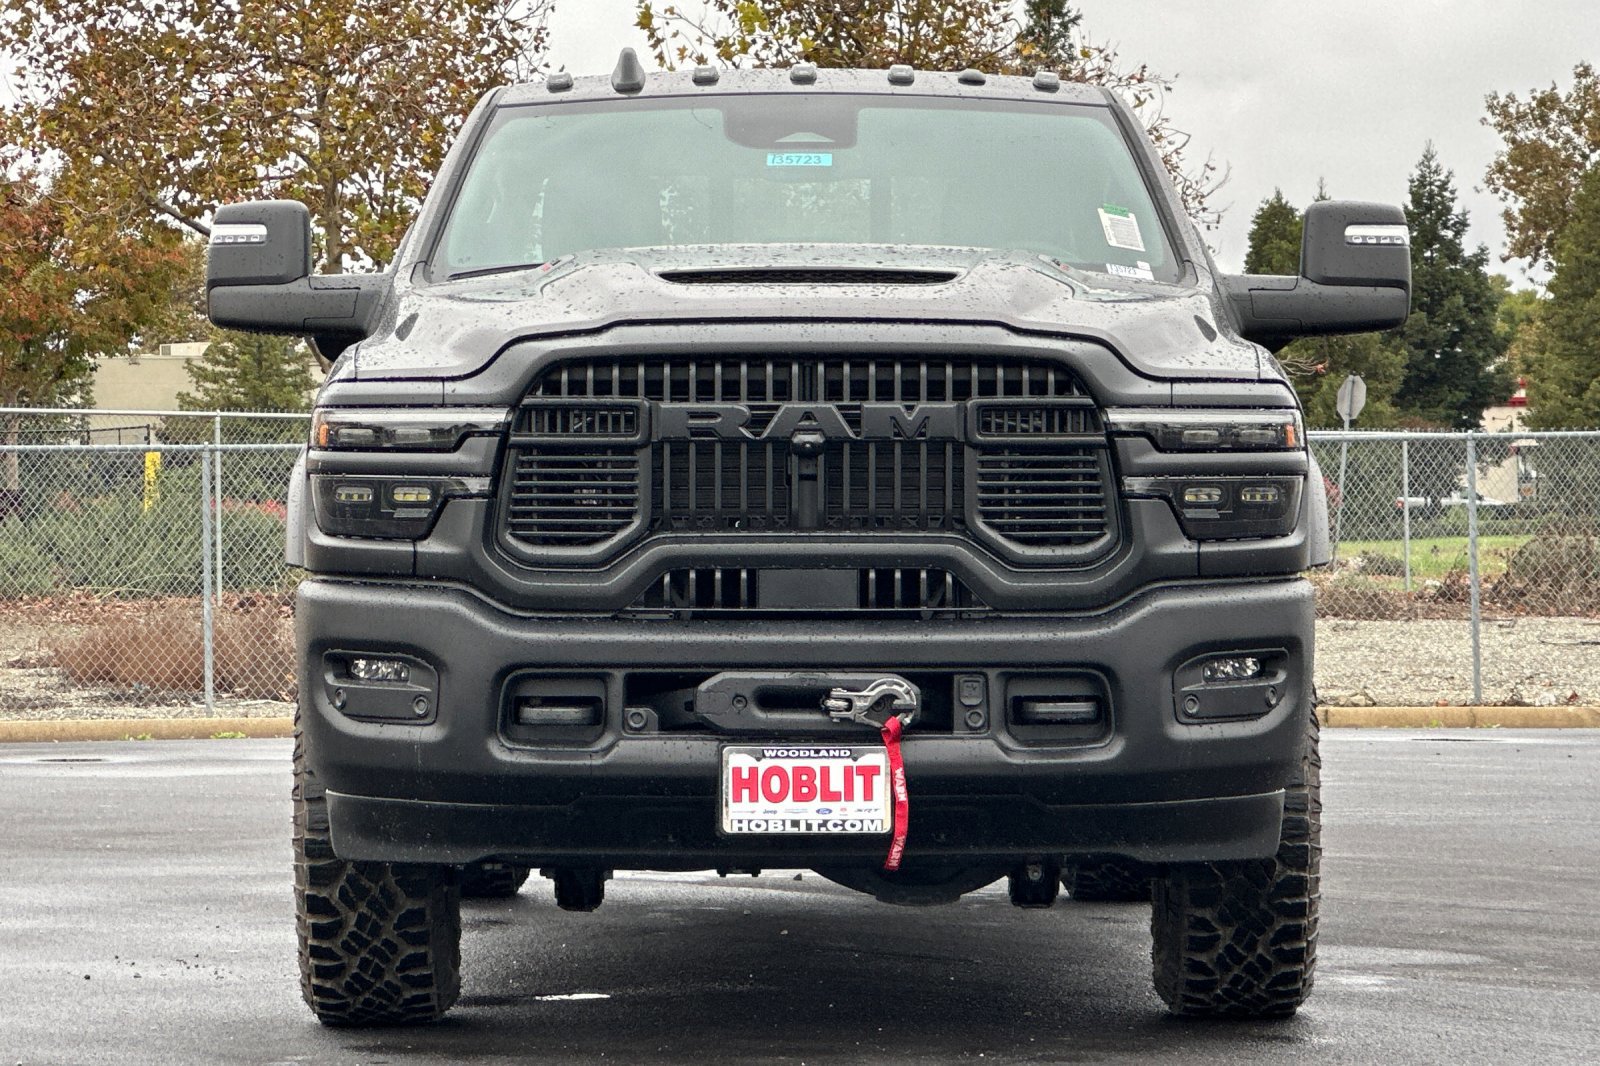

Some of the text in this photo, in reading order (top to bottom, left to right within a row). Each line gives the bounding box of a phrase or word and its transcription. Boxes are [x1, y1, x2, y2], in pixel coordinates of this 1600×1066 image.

[658, 402, 958, 441] RAM
[763, 749, 851, 758] WOODLAND
[731, 765, 881, 803] HOBLIT
[894, 767, 907, 801] WARN
[731, 819, 883, 831] HOBLIT.COM
[888, 835, 905, 867] WARN
